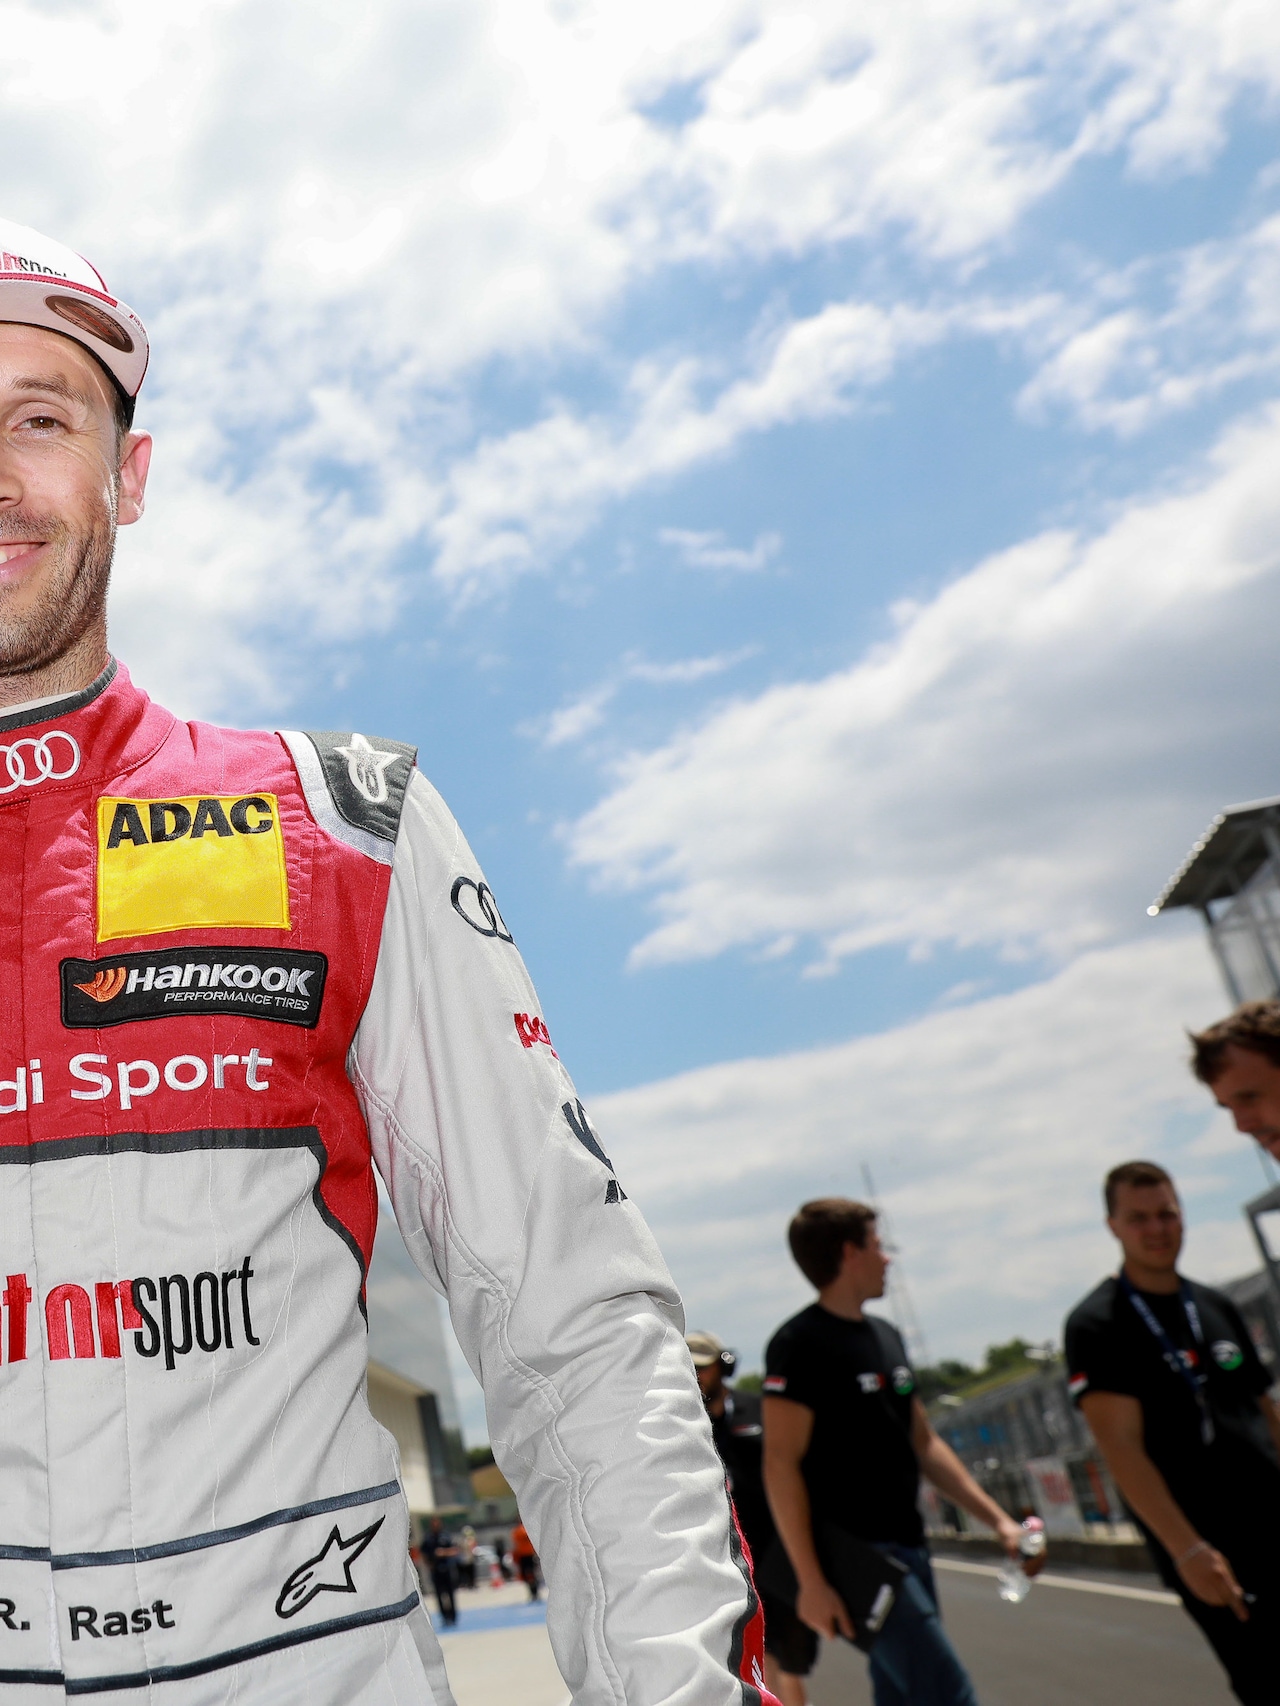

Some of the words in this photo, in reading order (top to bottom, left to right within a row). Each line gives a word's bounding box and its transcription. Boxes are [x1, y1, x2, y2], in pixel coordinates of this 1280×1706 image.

[106, 797, 272, 849] ADAC
[164, 991, 273, 1004] PERFORMANCE
[274, 998, 309, 1011] TIRES
[69, 1048, 273, 1110] Sport
[68, 1598, 175, 1640] Rast
